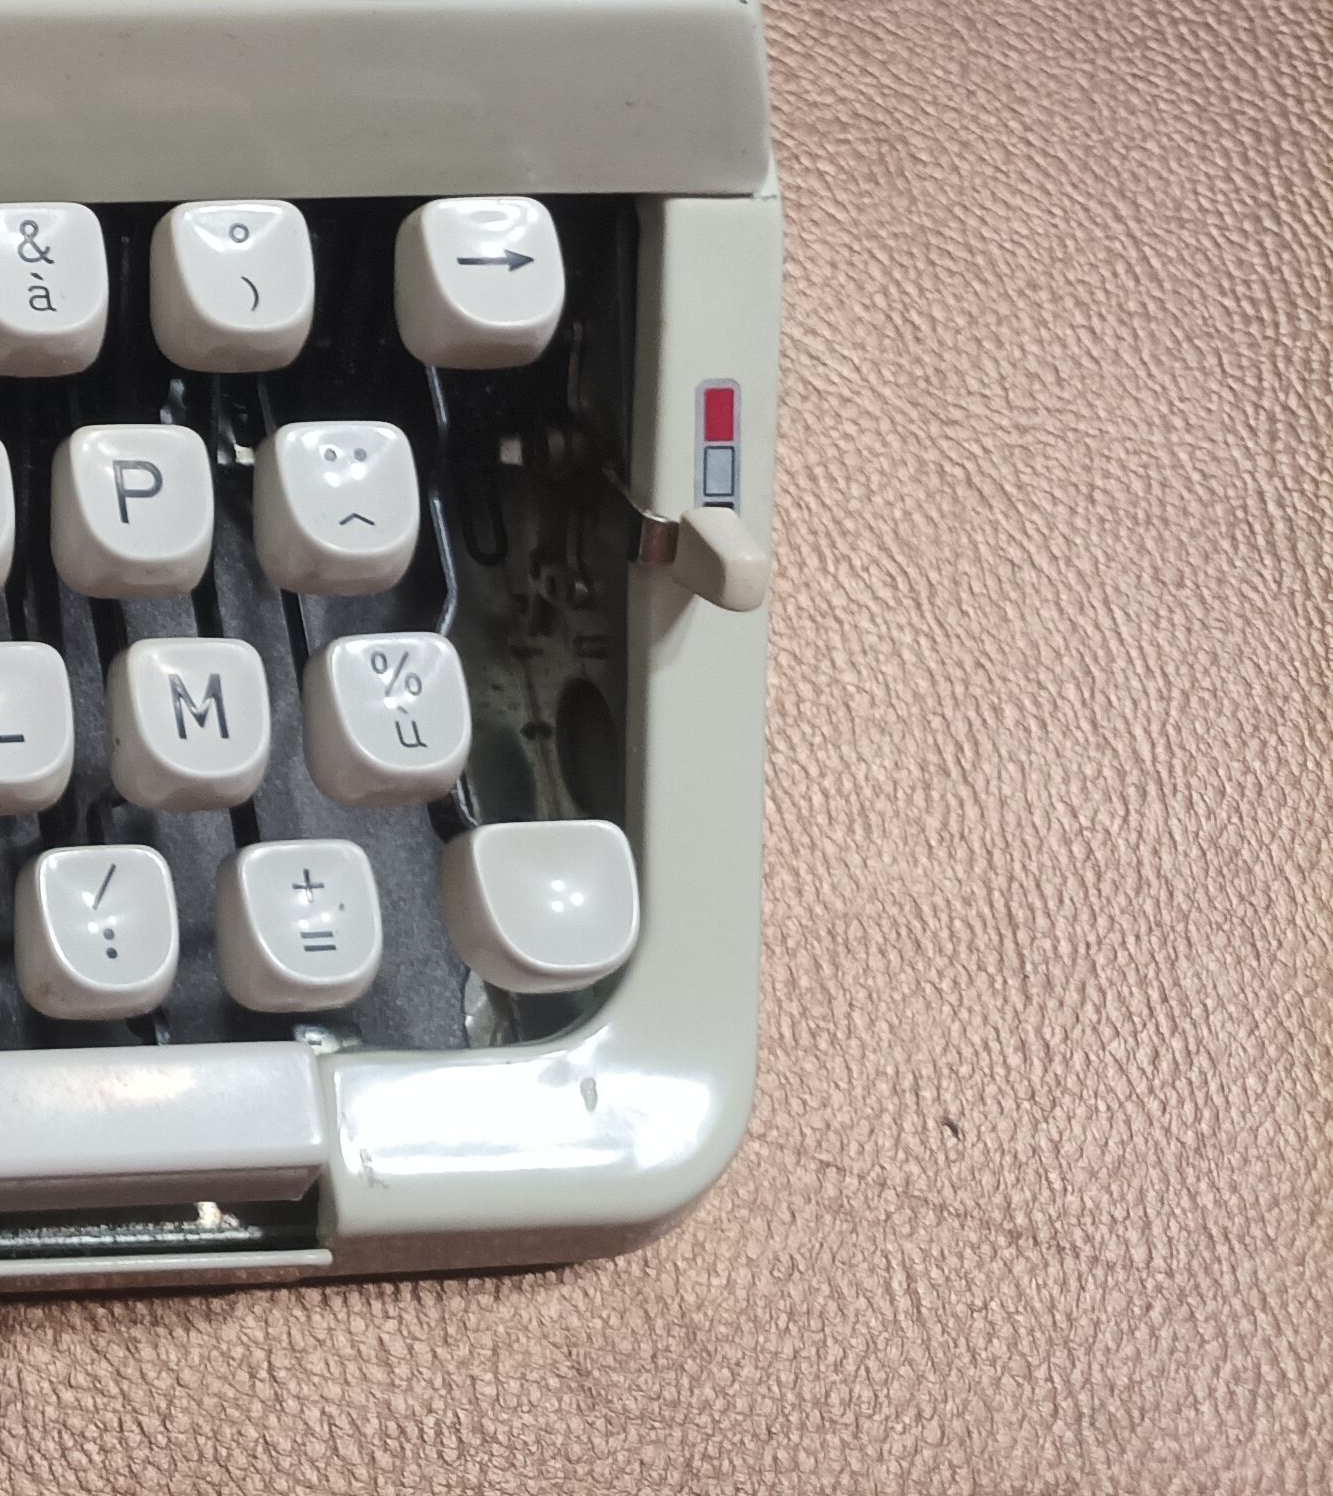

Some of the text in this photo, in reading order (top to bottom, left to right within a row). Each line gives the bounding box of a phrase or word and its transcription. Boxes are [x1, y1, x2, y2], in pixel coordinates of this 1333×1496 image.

[18, 220, 54, 264] &
[28, 273, 57, 311] à
[241, 276, 259, 311] )
[114, 461, 163, 523] P
[371, 652, 422, 695] %
[171, 674, 229, 739] M
[395, 708, 427, 748] ù
[95, 864, 116, 909] /
[292, 868, 324, 903] +
[104, 929, 117, 959] :
[301, 932, 336, 952] =
